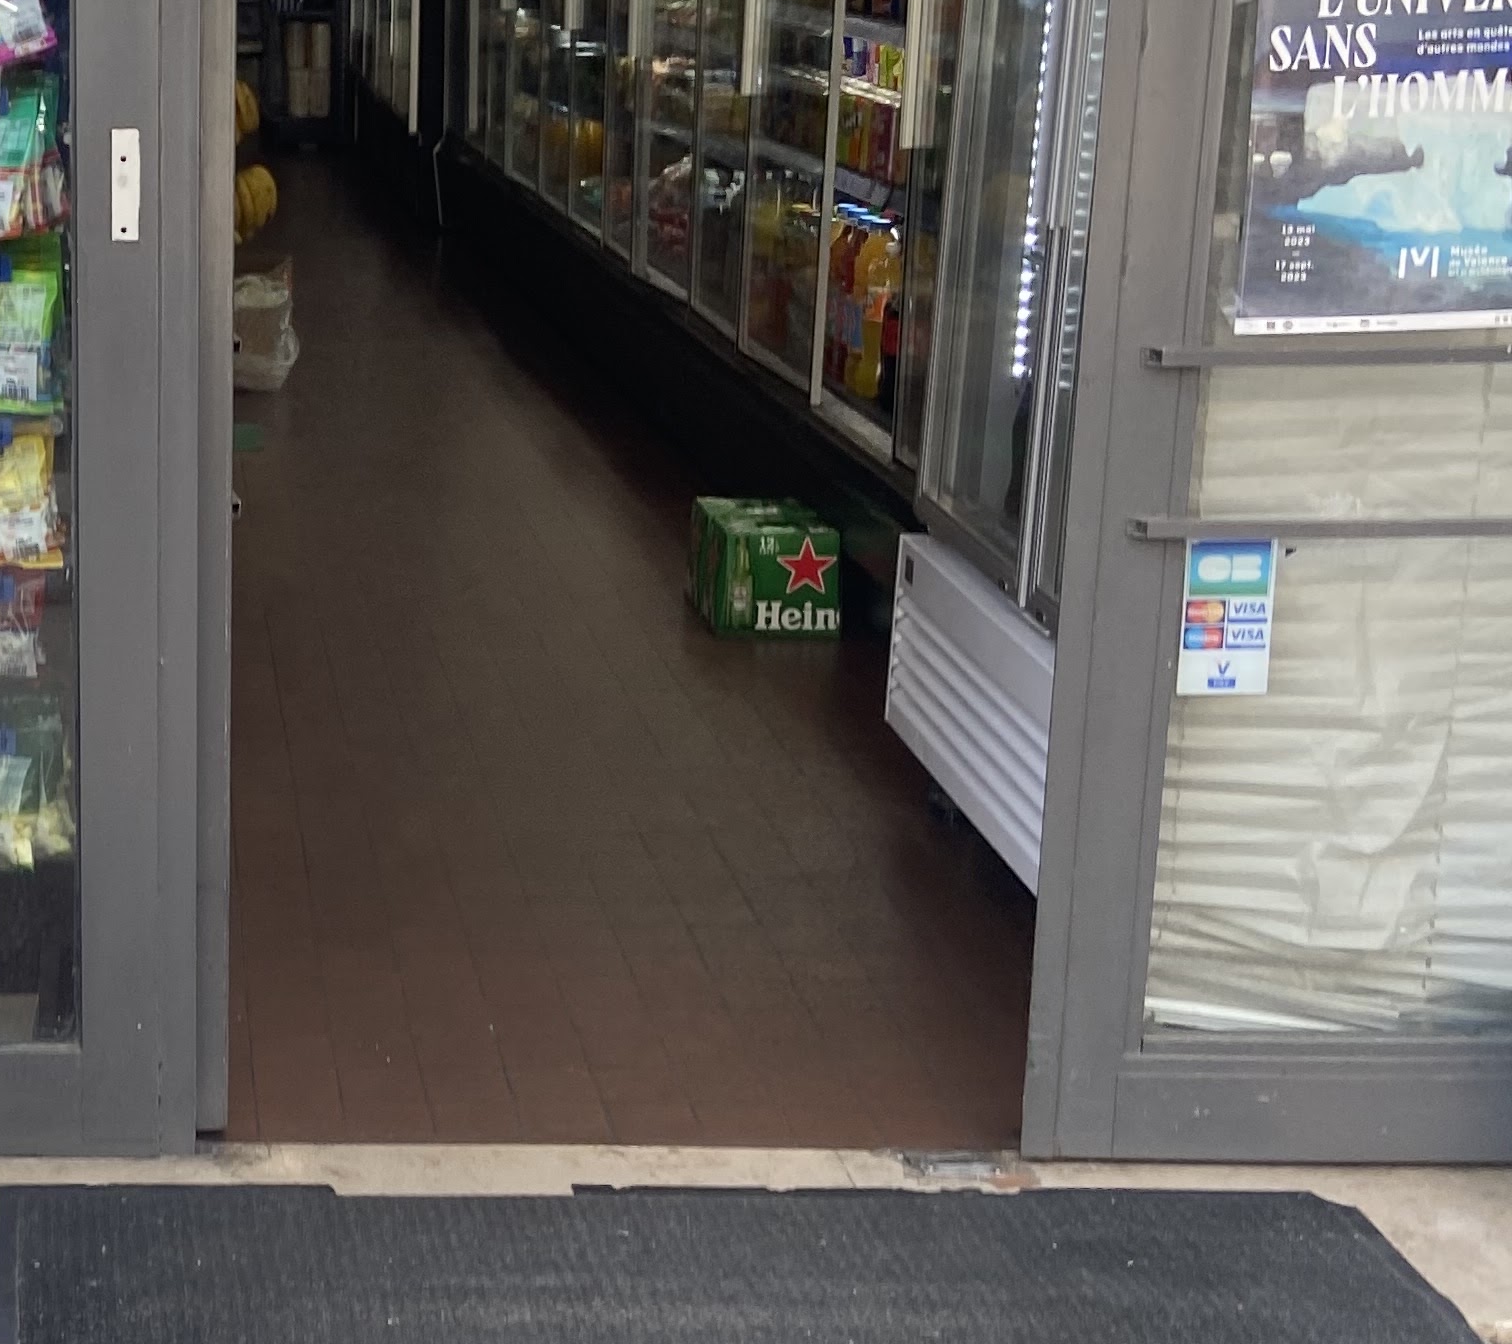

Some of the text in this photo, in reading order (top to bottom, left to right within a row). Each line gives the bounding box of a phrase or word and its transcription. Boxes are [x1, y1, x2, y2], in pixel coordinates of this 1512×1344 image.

[1418, 28, 1438, 41] Les
[1440, 27, 1464, 41] arts
[1466, 27, 1481, 39] en
[1269, 22, 1377, 72] SANS
[1333, 67, 1512, 120] L'HOMM
[754, 600, 841, 631] Hein
[1233, 602, 1267, 615] VISA
[1231, 627, 1265, 641] VISA
